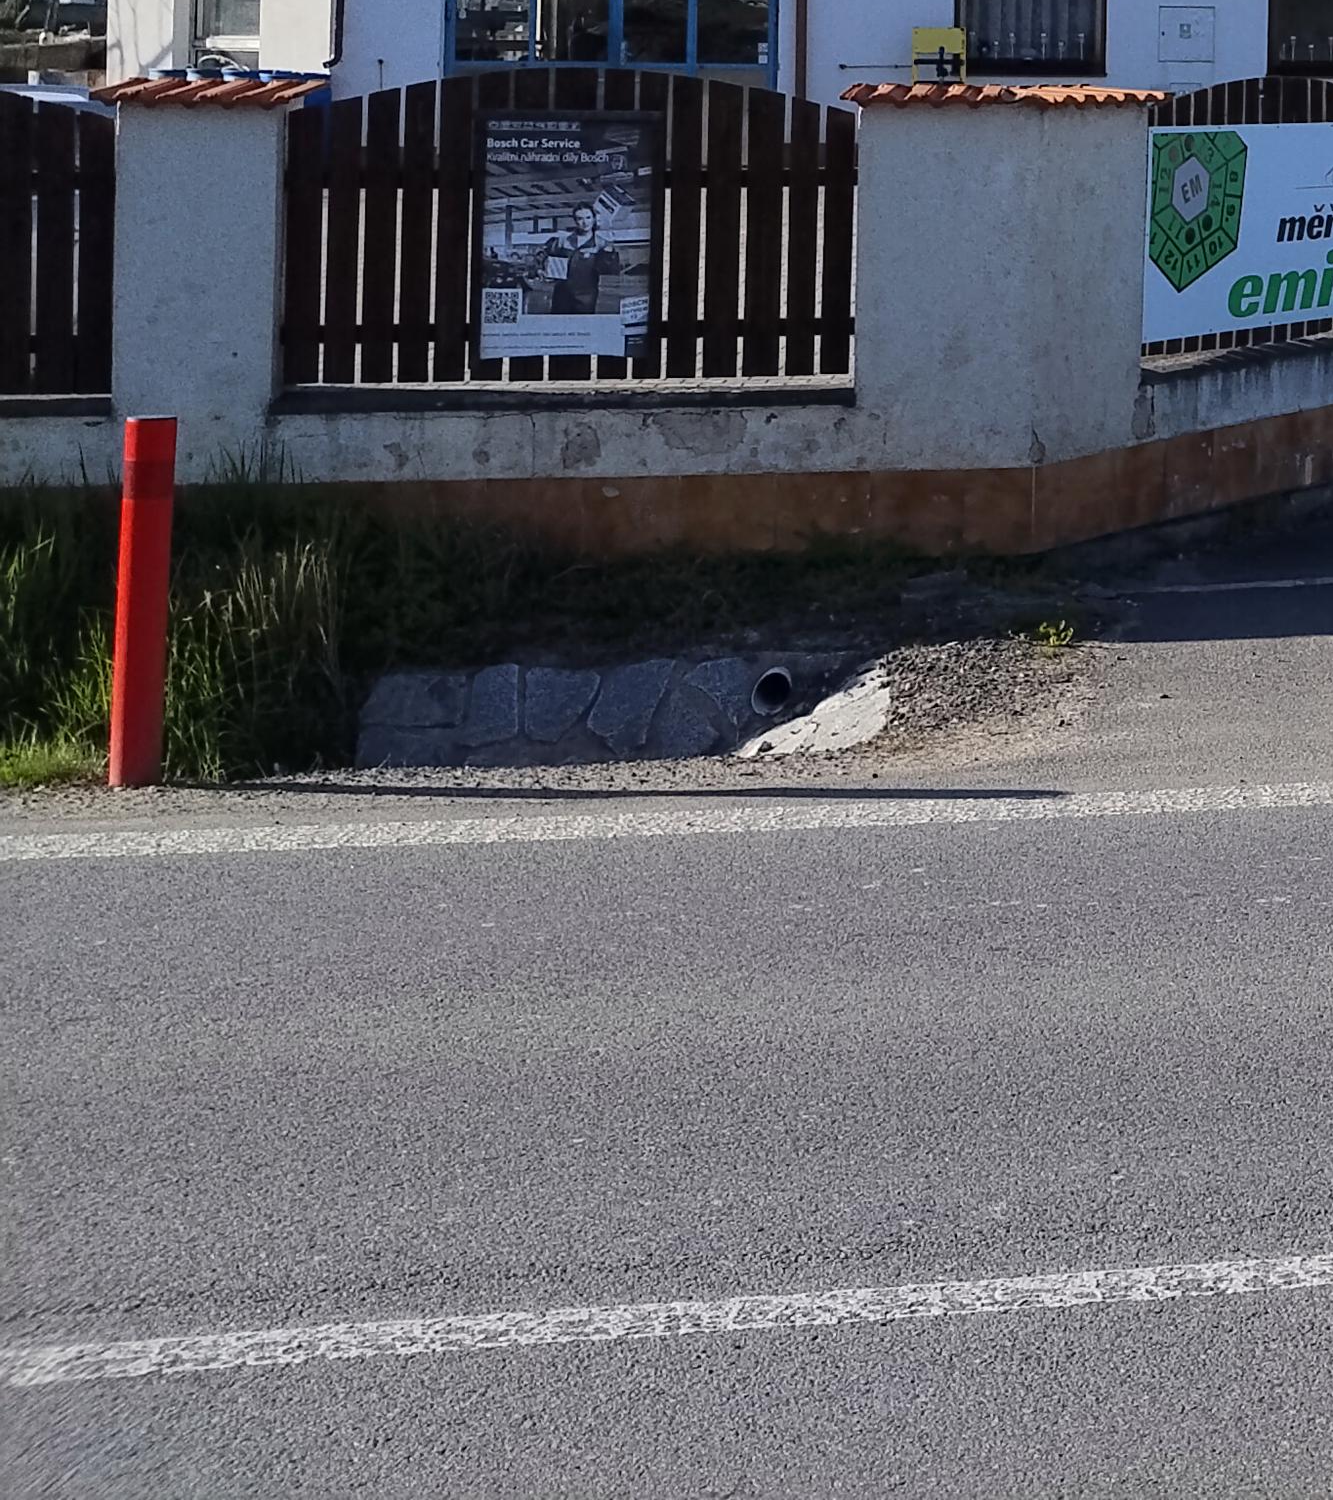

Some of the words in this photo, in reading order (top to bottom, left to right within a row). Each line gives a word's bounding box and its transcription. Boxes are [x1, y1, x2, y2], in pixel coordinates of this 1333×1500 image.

[486, 137, 519, 149] Bosch
[520, 138, 540, 149] Car
[541, 138, 581, 149] Service
[580, 152, 610, 163] Bosch
[1181, 173, 1203, 205] EM
[1208, 235, 1224, 256] 10
[1163, 250, 1179, 272] 12
